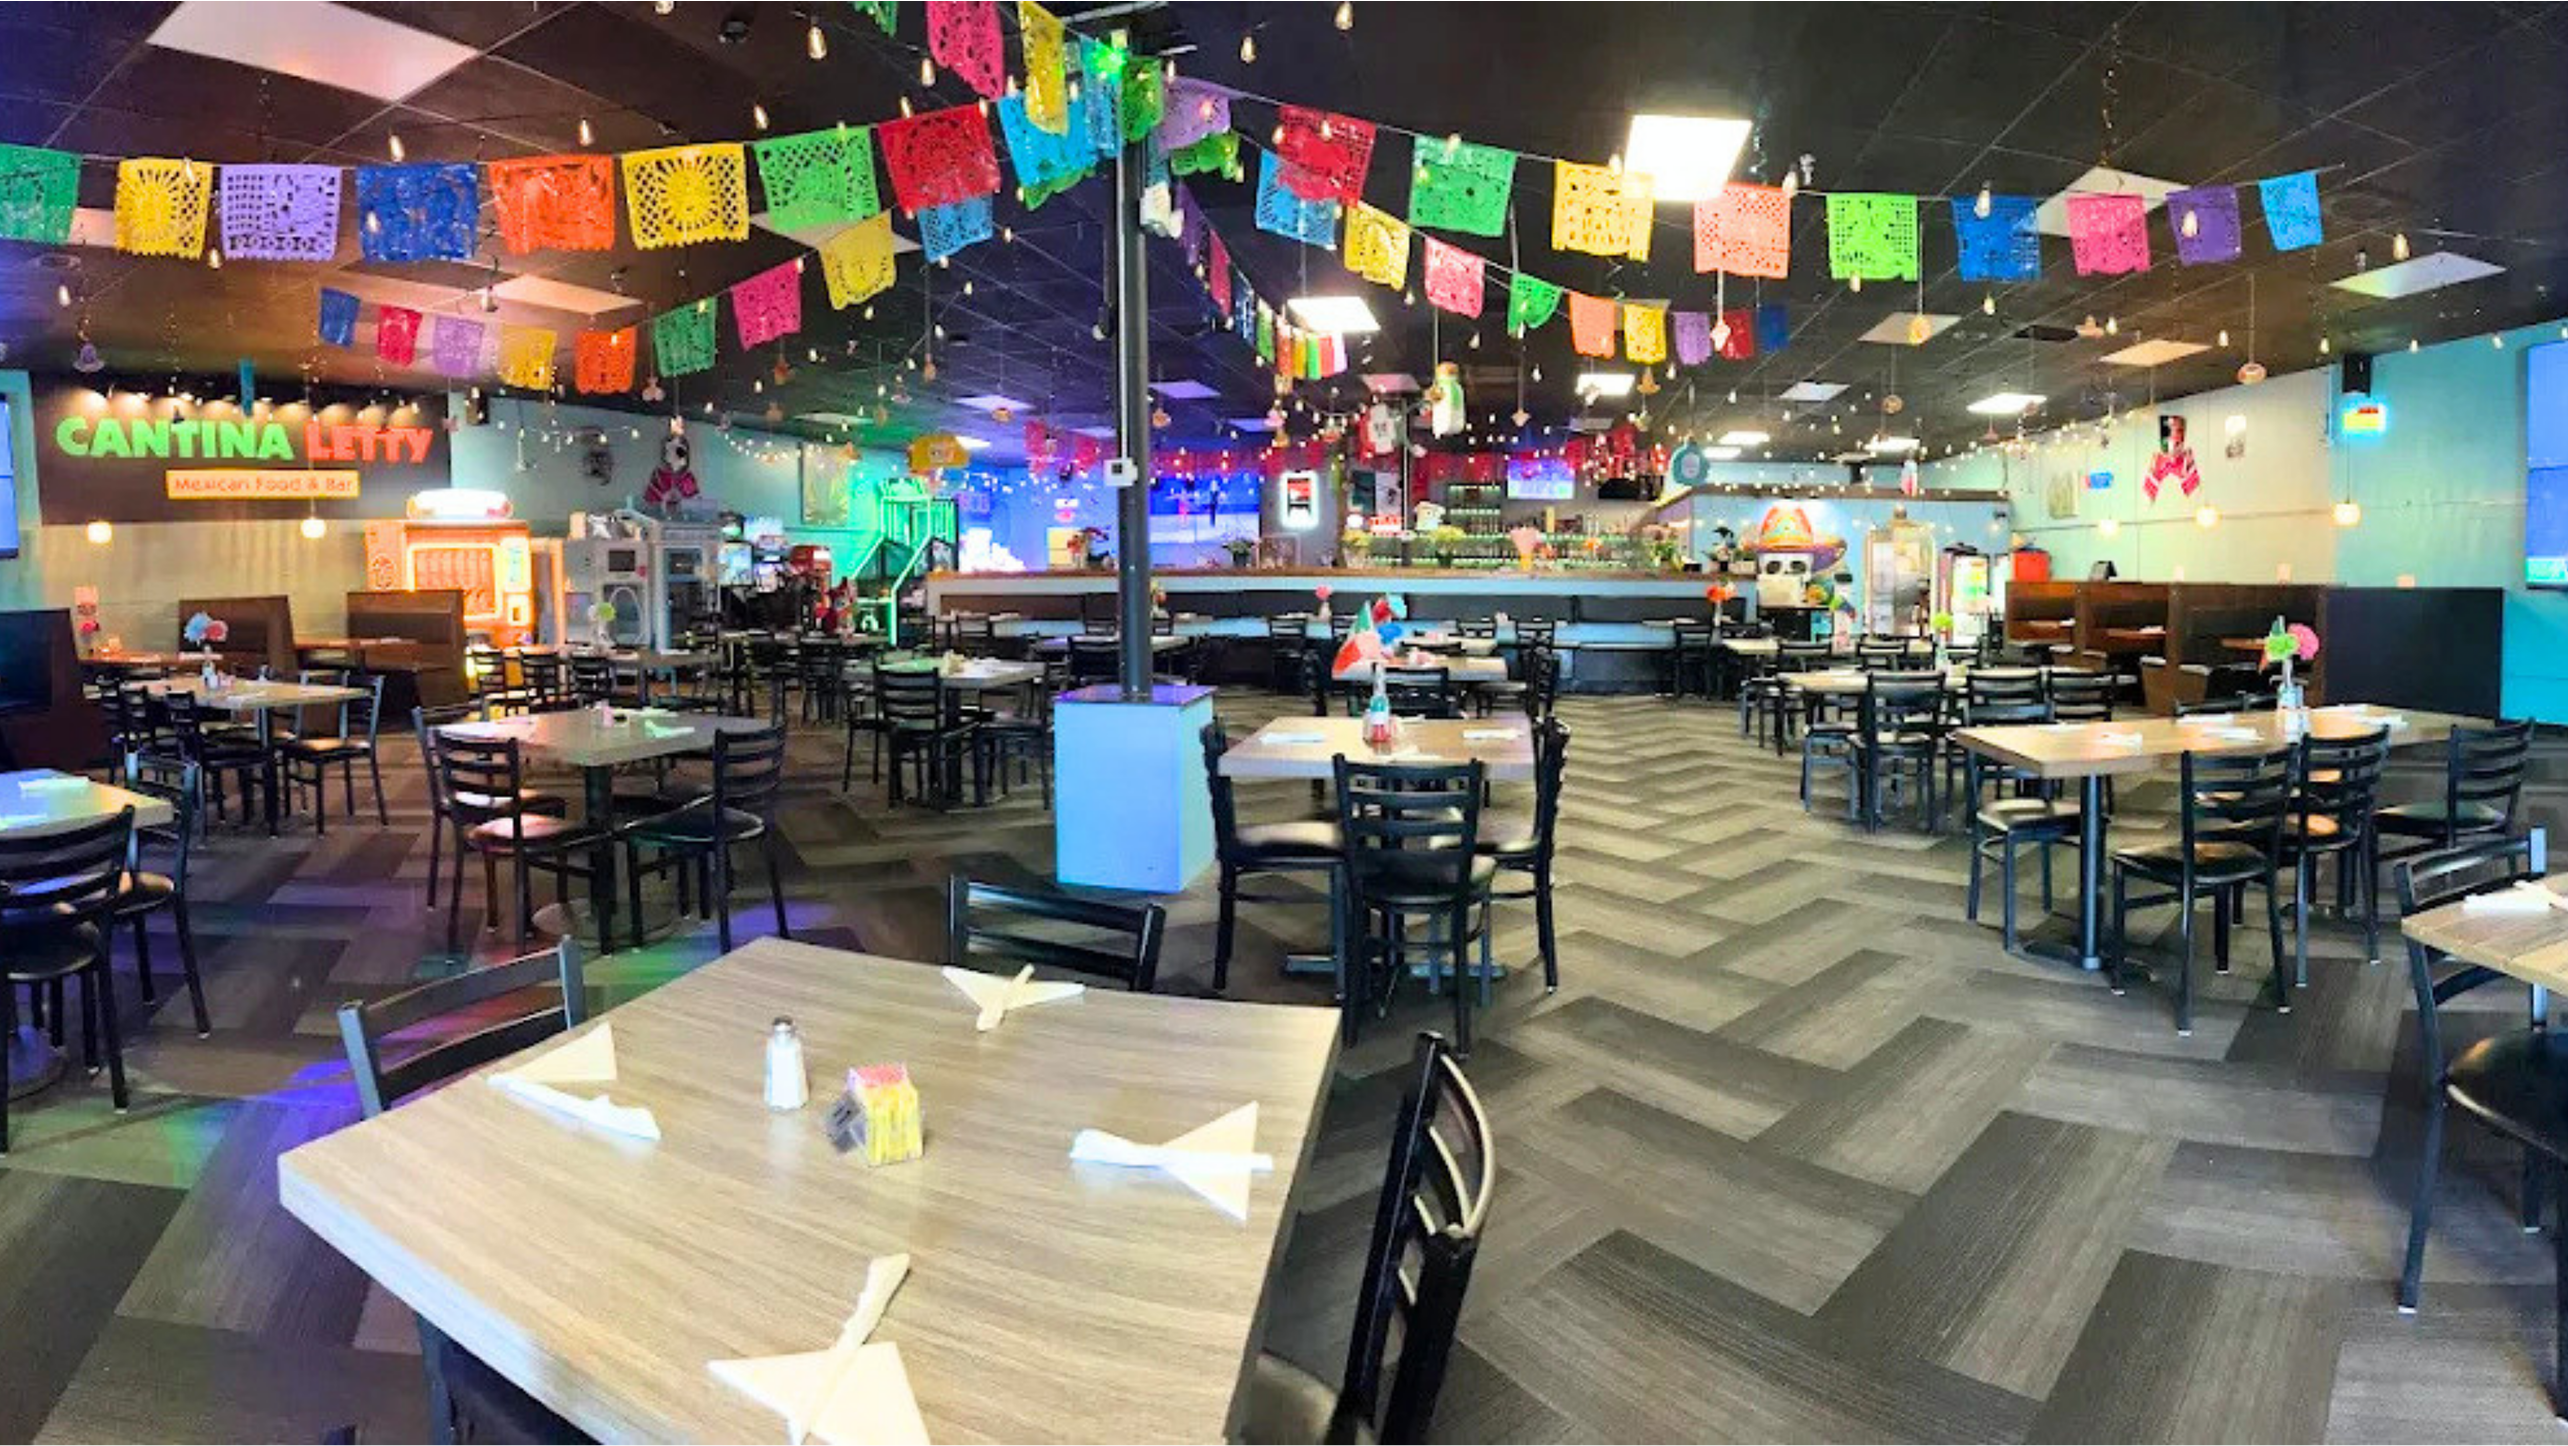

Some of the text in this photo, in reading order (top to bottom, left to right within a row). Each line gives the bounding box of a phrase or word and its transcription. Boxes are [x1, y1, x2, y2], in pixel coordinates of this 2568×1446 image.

[56, 416, 434, 464] CANTINA LETTY
[174, 476, 354, 493] Mexican Food & Bar
